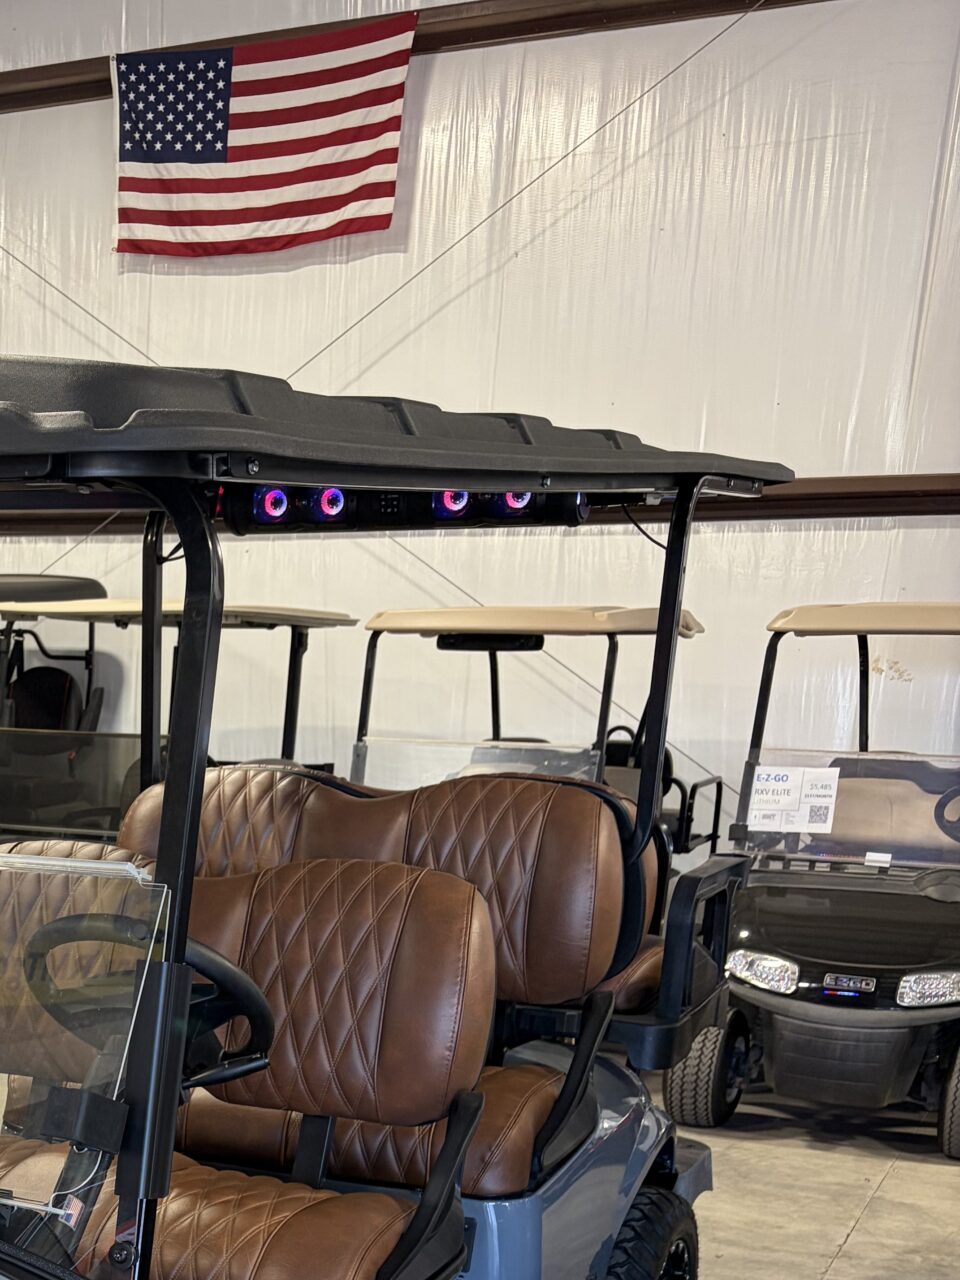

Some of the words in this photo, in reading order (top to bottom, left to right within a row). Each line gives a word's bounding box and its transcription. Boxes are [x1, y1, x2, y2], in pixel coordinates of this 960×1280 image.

[756, 773, 789, 783] E-Z-GO
[754, 788, 771, 797] RXV
[771, 788, 792, 797] ELITE
